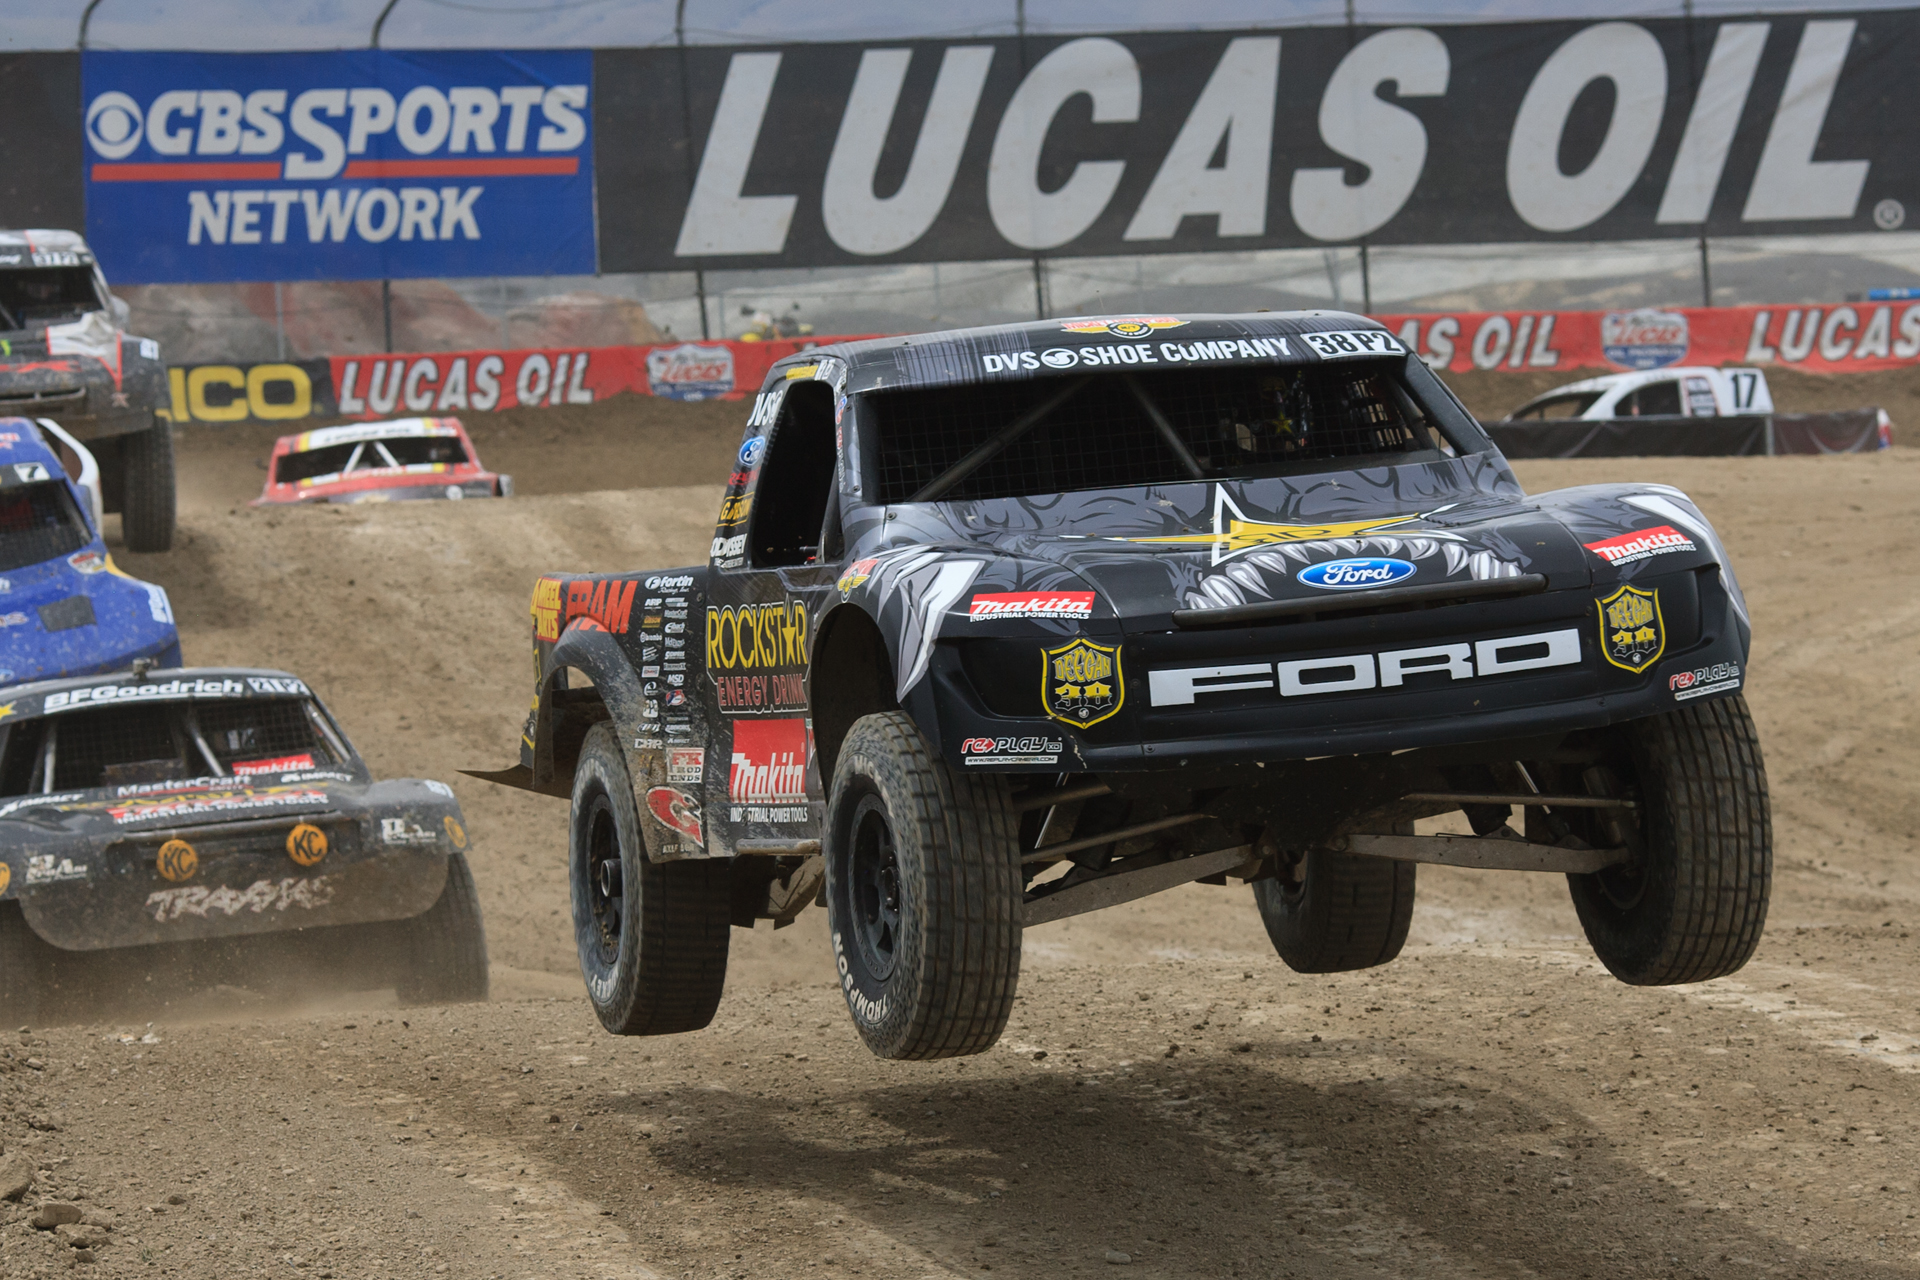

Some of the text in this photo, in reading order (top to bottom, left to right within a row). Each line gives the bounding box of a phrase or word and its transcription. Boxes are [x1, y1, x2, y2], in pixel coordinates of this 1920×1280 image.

[674, 20, 1871, 257] LUCAS OIL
[187, 186, 486, 245] NETWORK
[984, 337, 1292, 373] DVS SHOE COMPANY
[1470, 315, 1561, 370] OIL
[154, 364, 313, 422] ICO
[338, 352, 595, 416] LUCAS OIL
[1731, 373, 1758, 409] 17
[1593, 532, 1694, 562] makita
[1322, 561, 1394, 585] Ford
[969, 612, 1023, 623] INDUSTRIAL
[1059, 612, 1090, 620] TOOLS
[972, 598, 1093, 615] makita
[1052, 646, 1112, 683] DEEGAN
[1148, 628, 1582, 708] FORD
[44, 679, 244, 710] BFGoodrich
[717, 673, 807, 707] ENERGY DRINK
[117, 775, 253, 797] MasterCraft
[301, 771, 353, 782] IMPACT
[670, 774, 701, 782] ENDS
[293, 830, 322, 859] KC
[163, 848, 194, 877] KC
[833, 932, 890, 1021] THOMPSON
